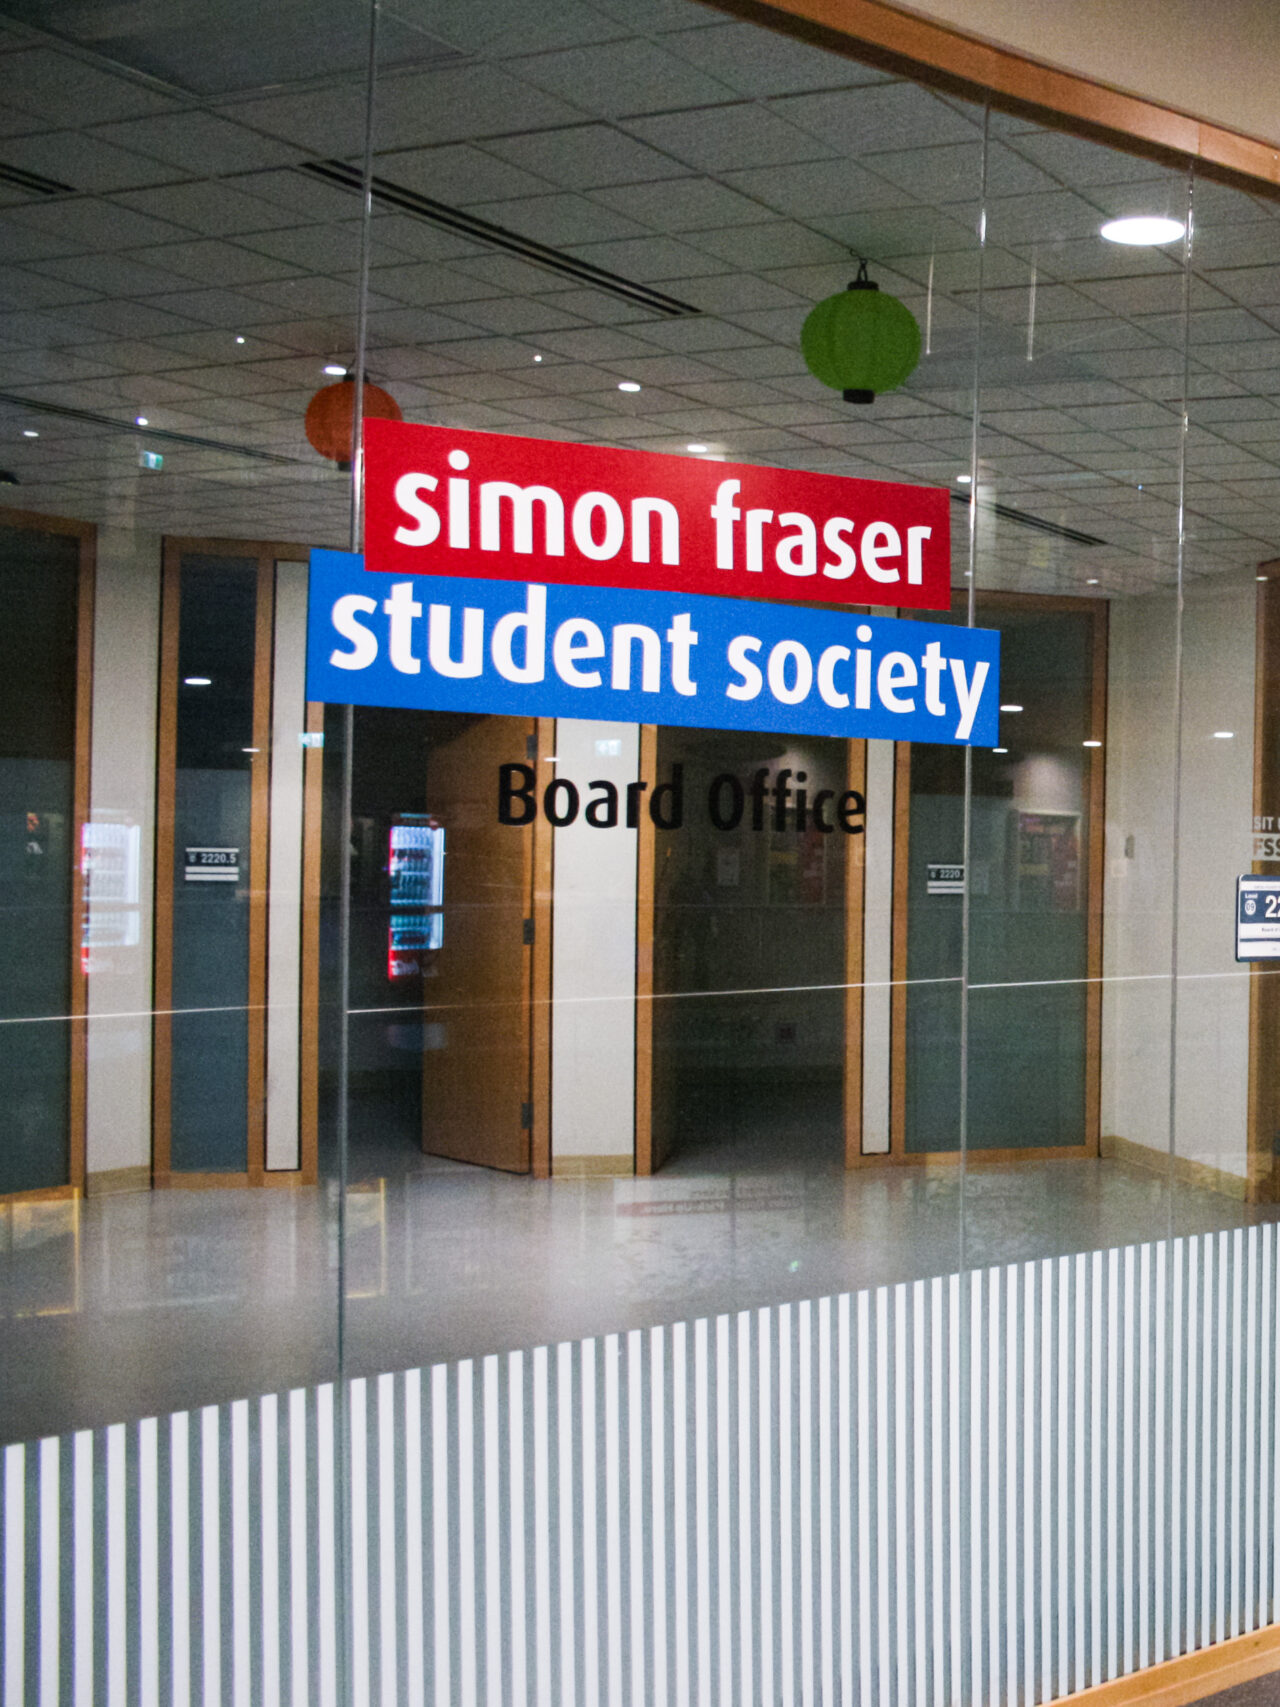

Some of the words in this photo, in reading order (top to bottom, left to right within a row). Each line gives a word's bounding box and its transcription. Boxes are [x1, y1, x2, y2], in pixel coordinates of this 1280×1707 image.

[393, 449, 681, 567] simon
[710, 478, 932, 586] fraser
[329, 581, 699, 696] student
[725, 624, 990, 740] society
[497, 763, 684, 829] Board
[709, 768, 867, 834] Office
